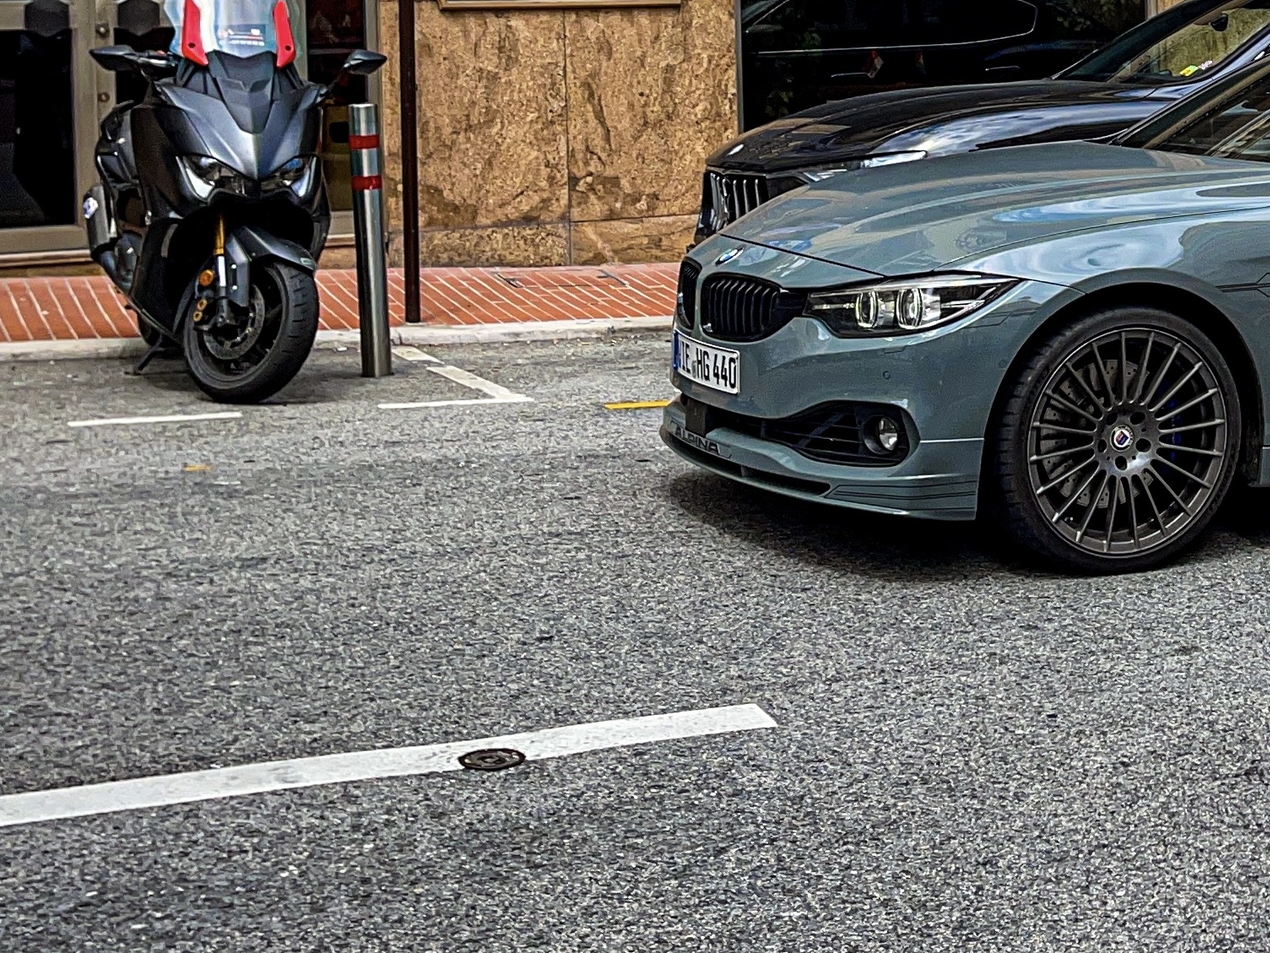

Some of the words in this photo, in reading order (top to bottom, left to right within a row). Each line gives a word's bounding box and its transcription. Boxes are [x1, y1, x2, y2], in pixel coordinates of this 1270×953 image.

[696, 347, 710, 382] HG
[713, 353, 737, 389] 440
[675, 425, 720, 458] ALPINA
